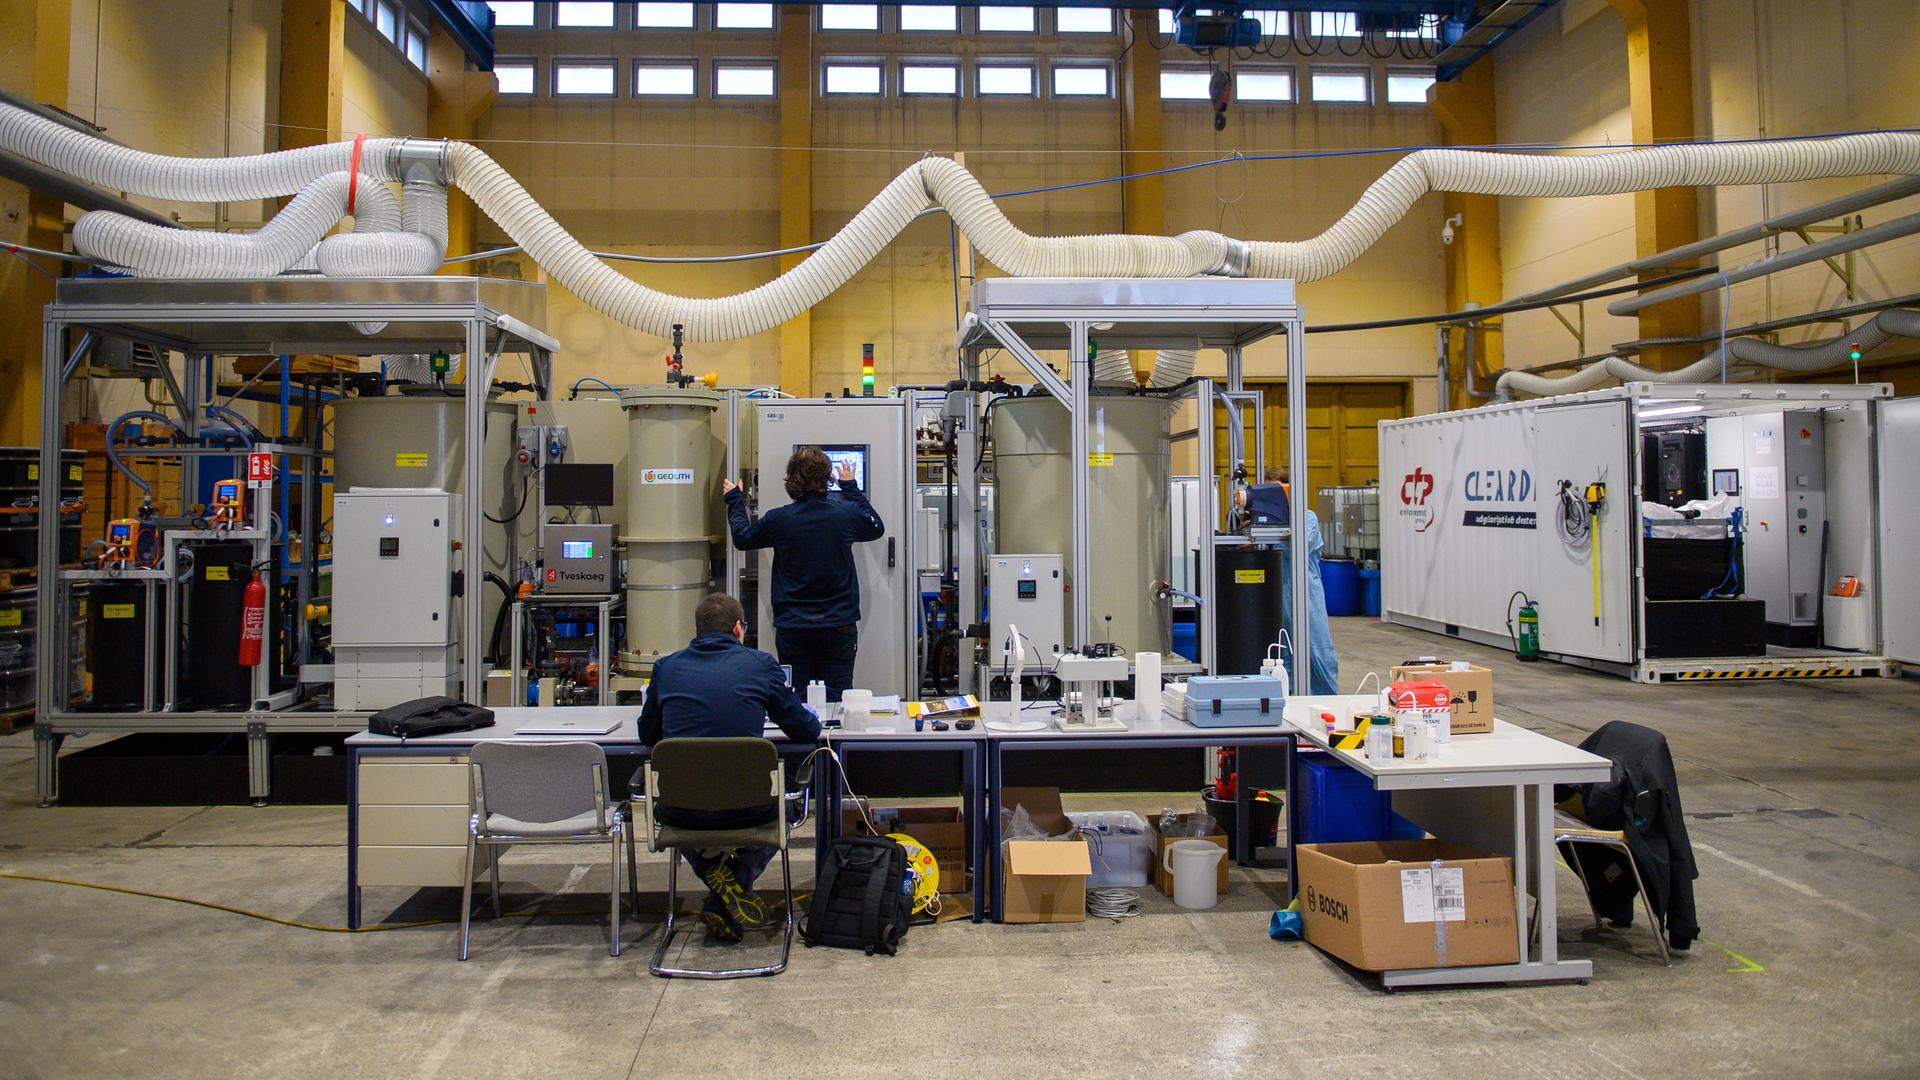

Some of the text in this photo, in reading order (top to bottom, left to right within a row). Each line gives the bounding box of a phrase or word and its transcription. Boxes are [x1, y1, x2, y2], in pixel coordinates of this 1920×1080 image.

[1464, 469, 1537, 502] CLEARD
[560, 571, 605, 583] Tveskaeg
[1318, 893, 1349, 924] BOSCH
